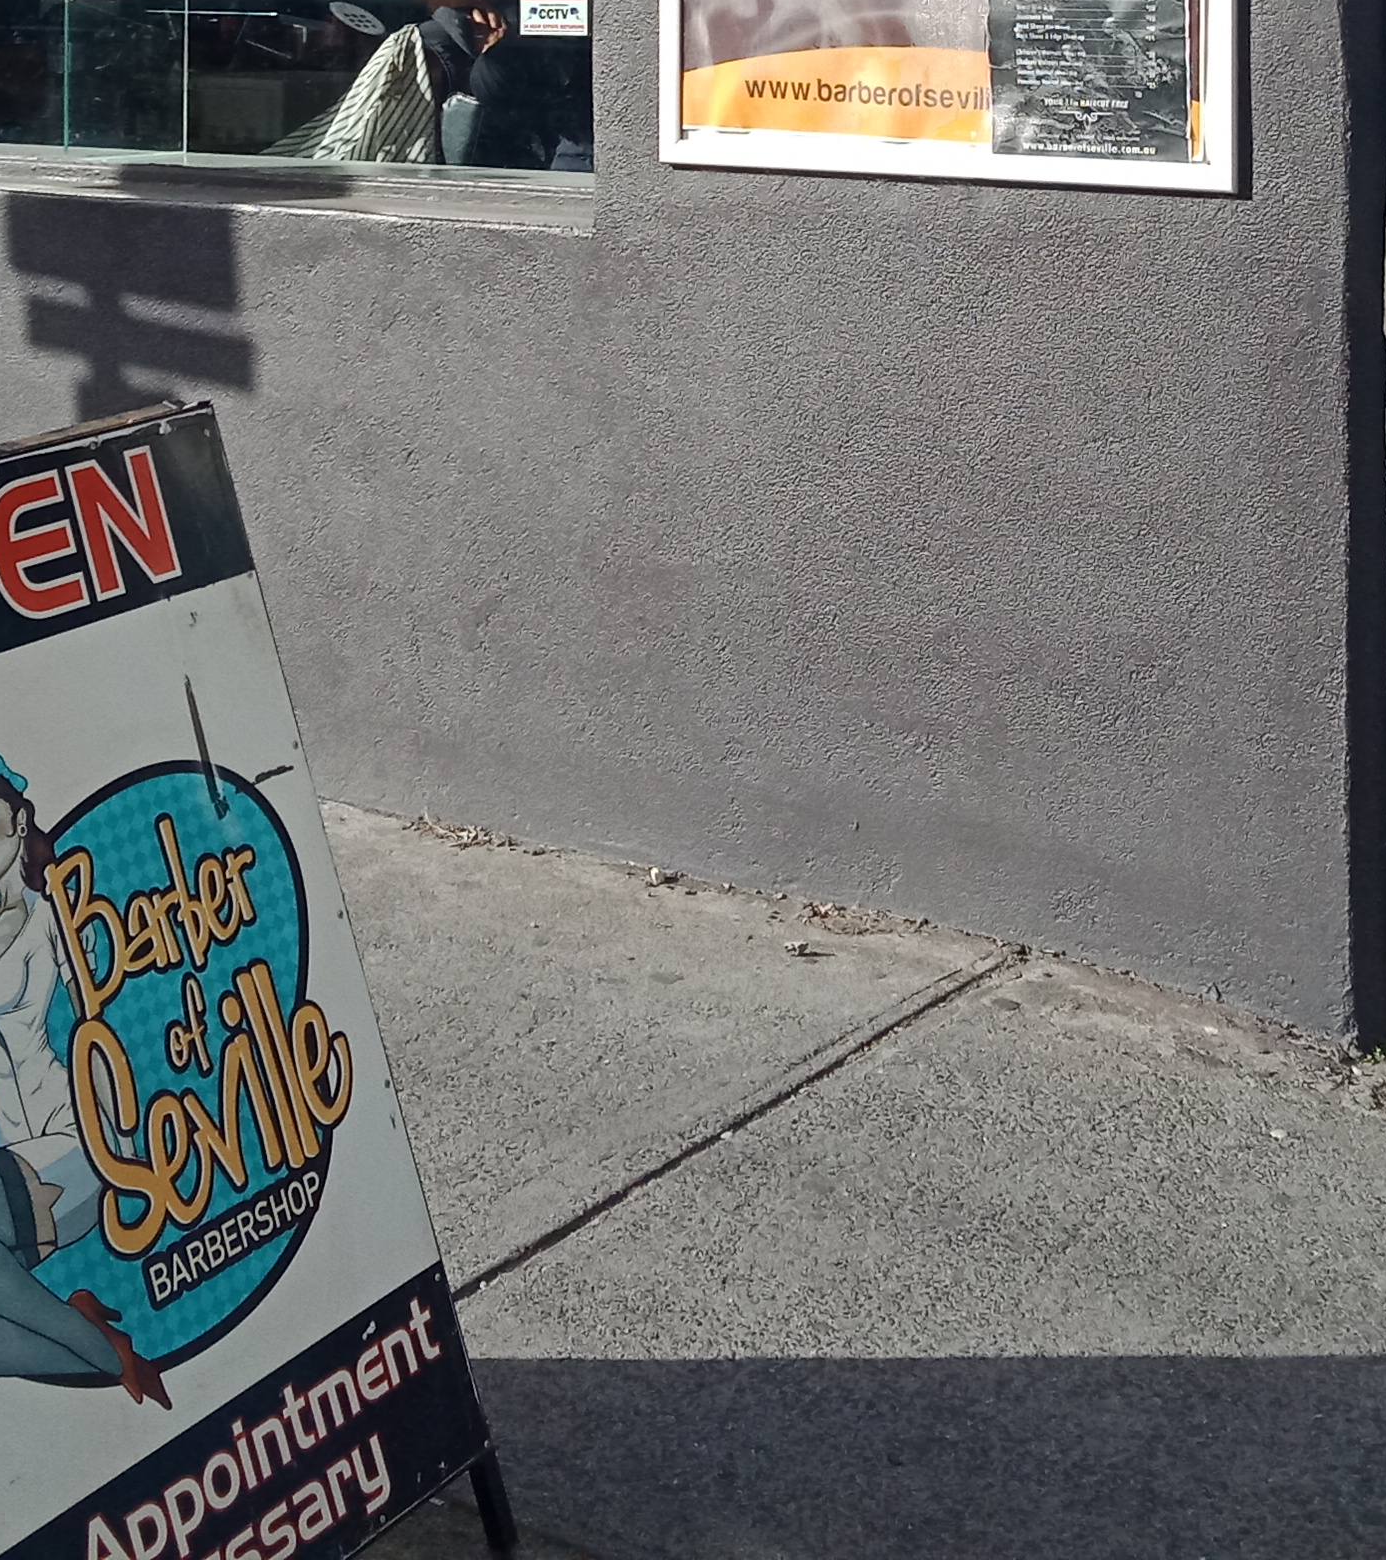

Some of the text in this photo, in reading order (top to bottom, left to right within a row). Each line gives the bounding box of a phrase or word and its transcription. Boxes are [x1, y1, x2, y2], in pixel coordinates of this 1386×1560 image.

[538, 8, 569, 20] CCTV
[44, 815, 256, 1020] Barber
[167, 975, 213, 1075] of
[69, 960, 353, 1255] Seville
[149, 1171, 321, 1302] BARBERSHOP
[87, 1297, 442, 1560] Appointment
[203, 1434, 392, 1560] ssary
